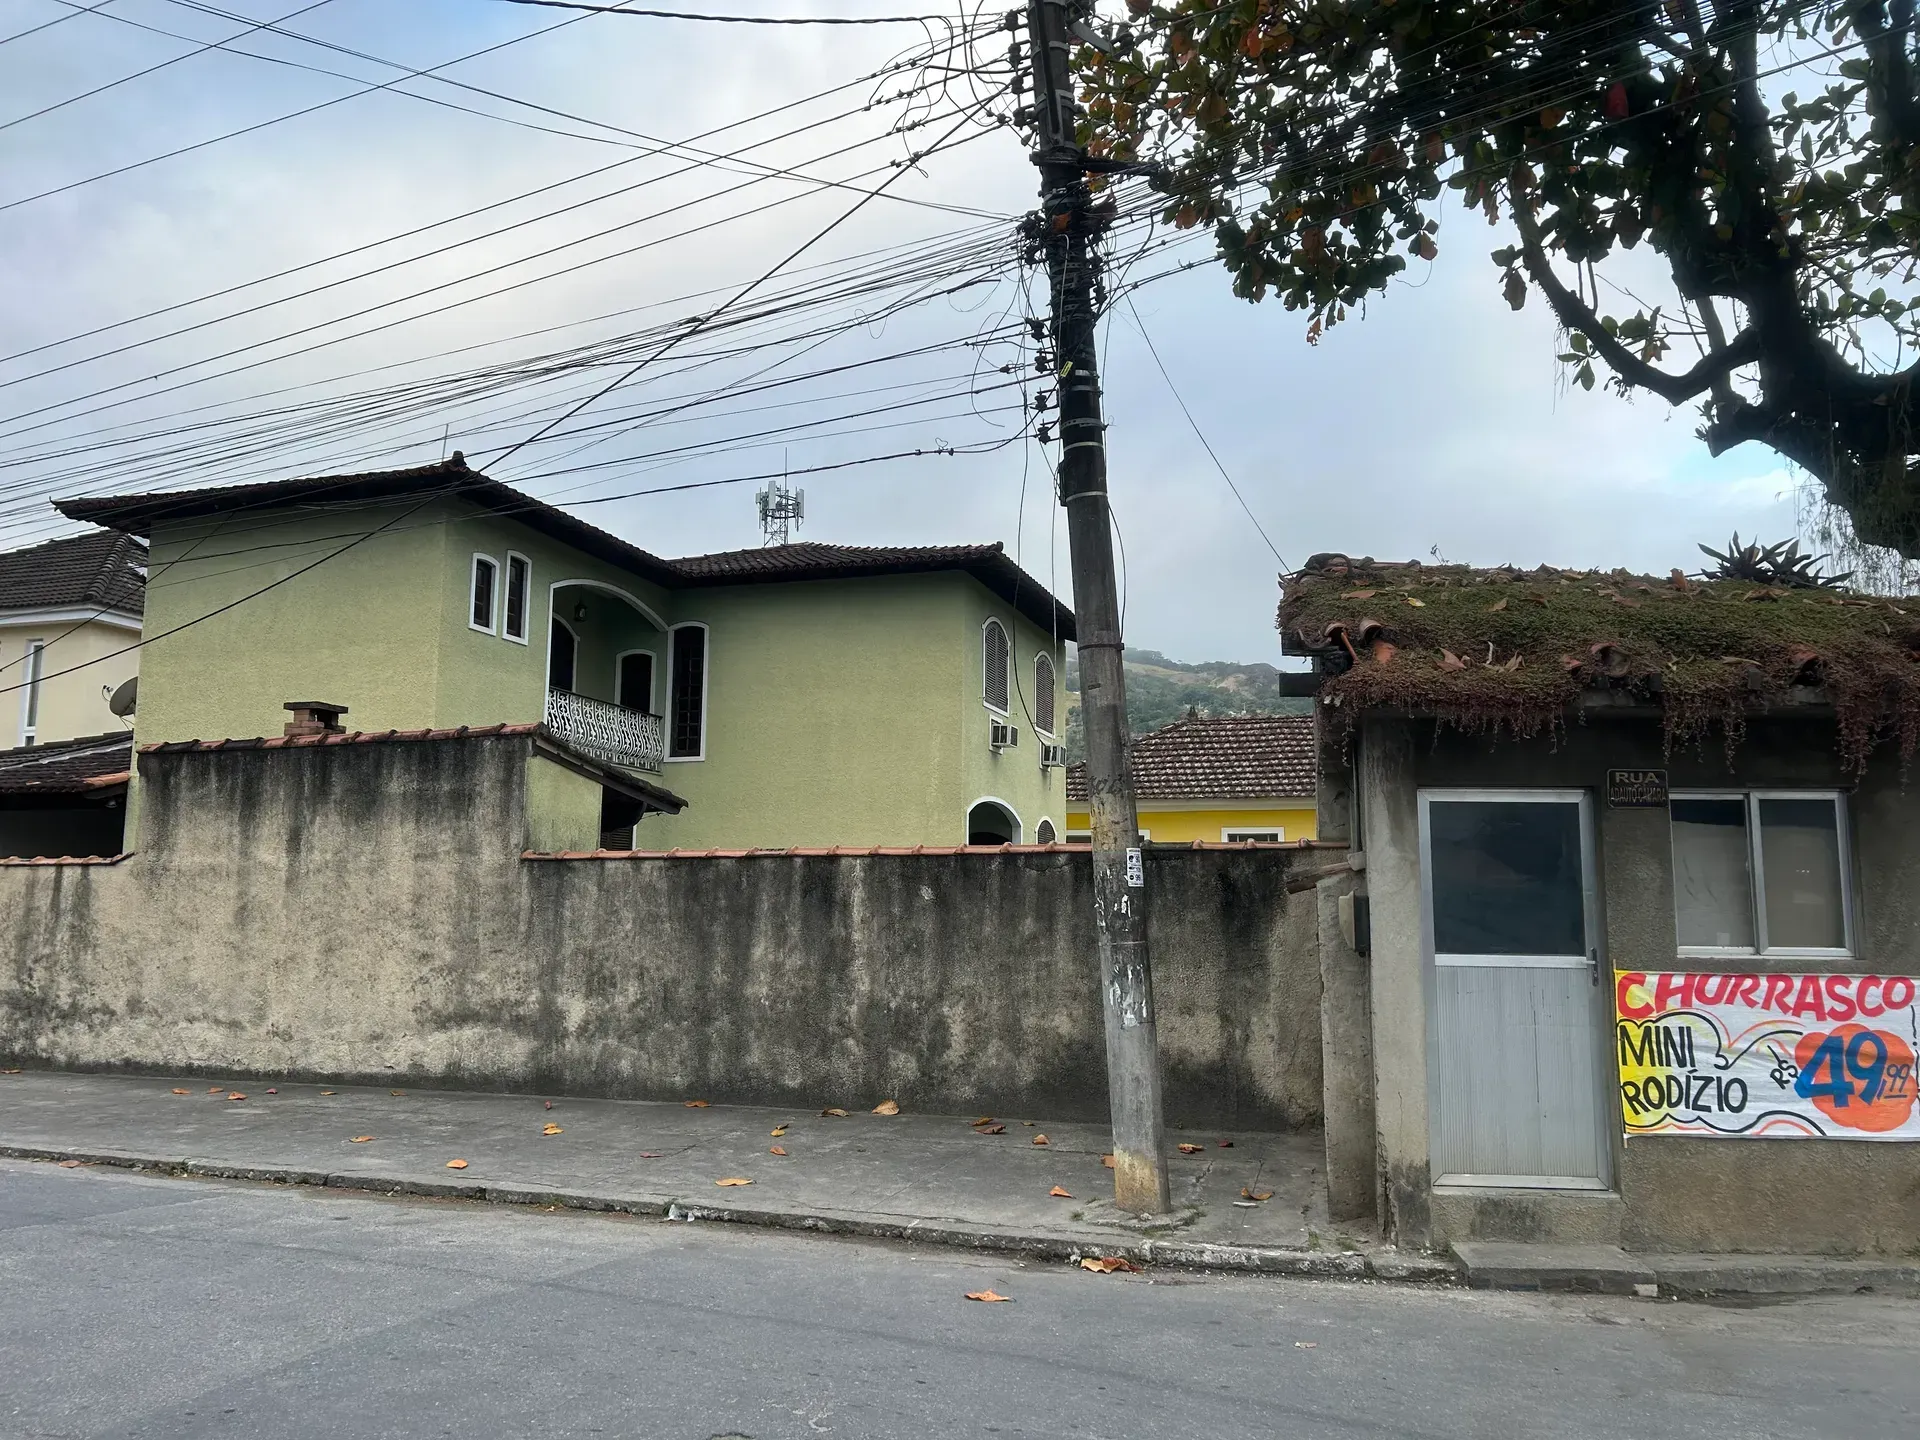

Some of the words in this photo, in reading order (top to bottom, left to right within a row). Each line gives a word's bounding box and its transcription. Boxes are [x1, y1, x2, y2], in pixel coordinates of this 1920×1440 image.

[1615, 772, 1659, 783] RUA
[1617, 972, 1915, 1021] CHURRASCO
[1619, 1025, 1696, 1067] MINI
[1770, 1050, 1799, 1090] R$
[1621, 1070, 1748, 1115] RODÍZIO
